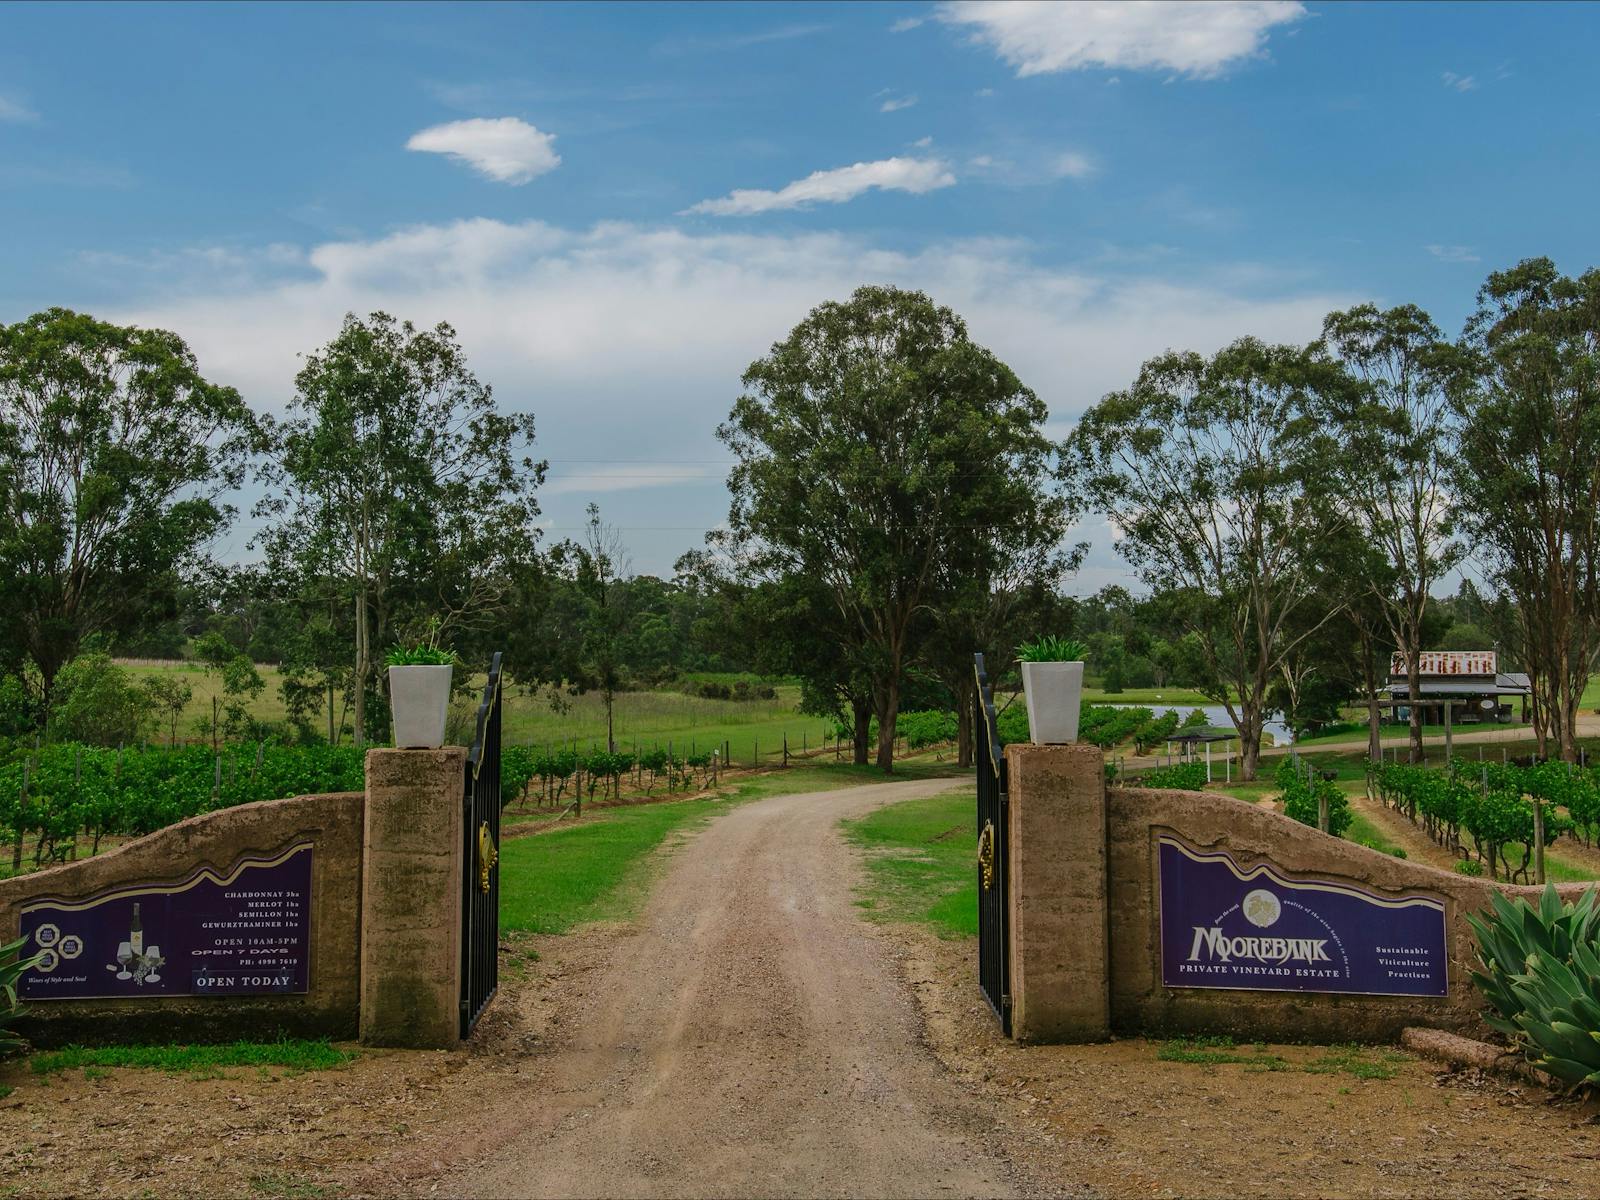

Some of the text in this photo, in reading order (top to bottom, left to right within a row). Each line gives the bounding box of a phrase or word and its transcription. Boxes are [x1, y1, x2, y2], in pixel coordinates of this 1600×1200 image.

[1283, 900, 1304, 910] quality
[1186, 926, 1333, 966] MOOREBANK
[1376, 946, 1428, 954] Sustainable
[1378, 958, 1430, 966] Viticulture
[1180, 964, 1340, 978] PRIVATE VINEYARD ESTATE
[1388, 970, 1430, 978] Practises
[44, 976, 50, 984] of
[50, 976, 62, 984] Style
[196, 976, 290, 987] OPEN TODAY
